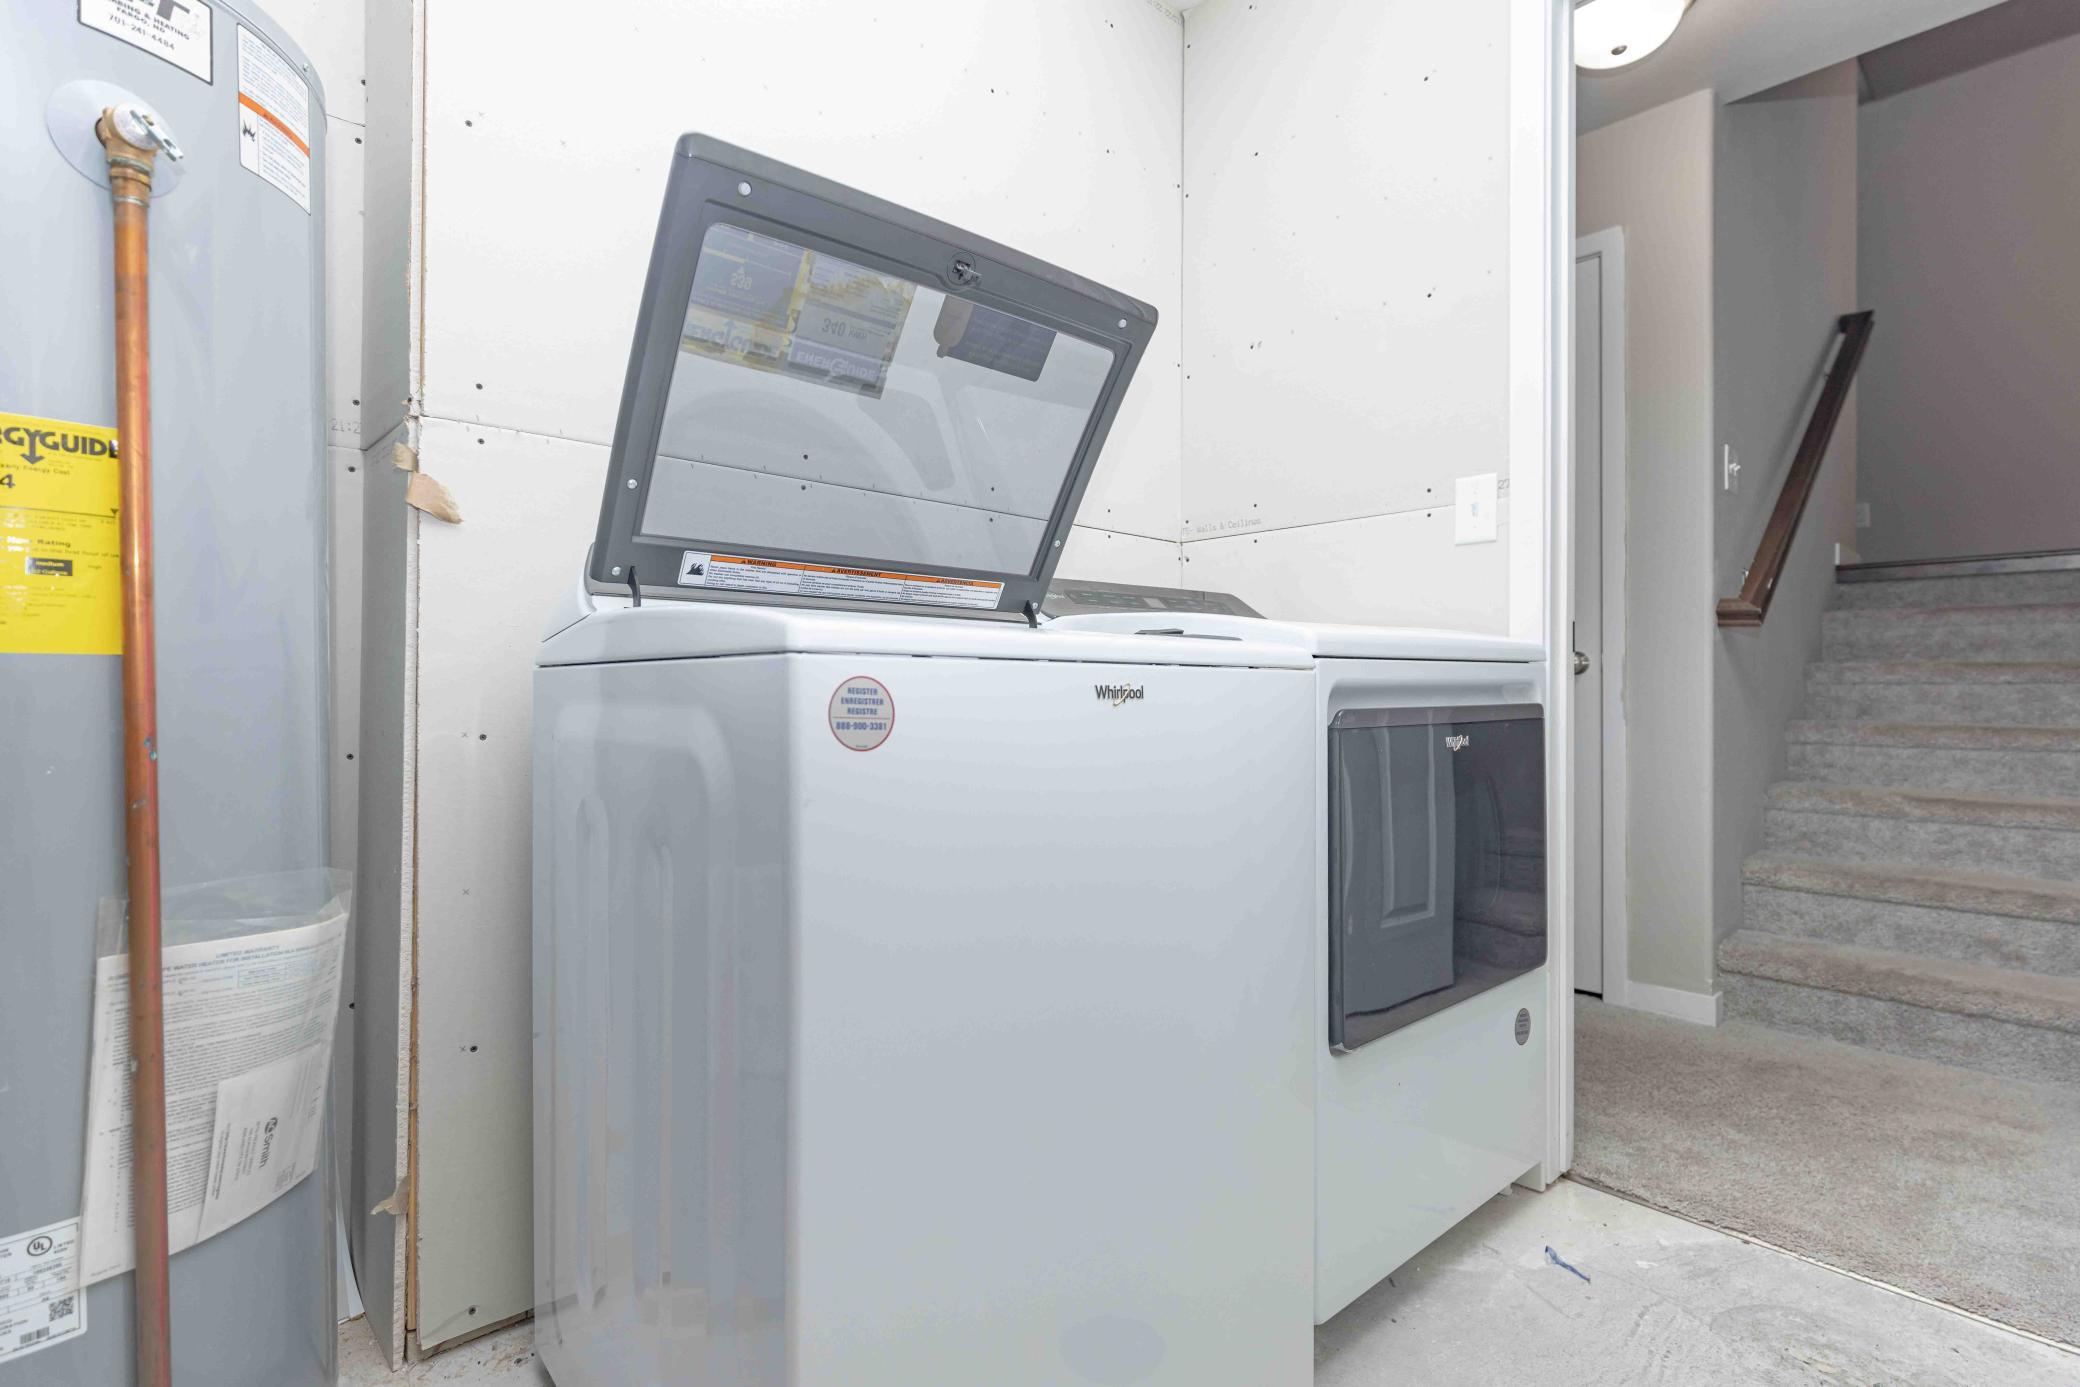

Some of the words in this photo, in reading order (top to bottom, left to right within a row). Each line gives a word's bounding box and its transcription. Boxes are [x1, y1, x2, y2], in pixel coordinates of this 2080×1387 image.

[154, 17, 190, 40] HEATING
[747, 558, 777, 567] WARNING
[847, 687, 878, 695] REGISTER
[1094, 683, 1144, 706] Whirlpool
[32, 1241, 47, 1251] UL
